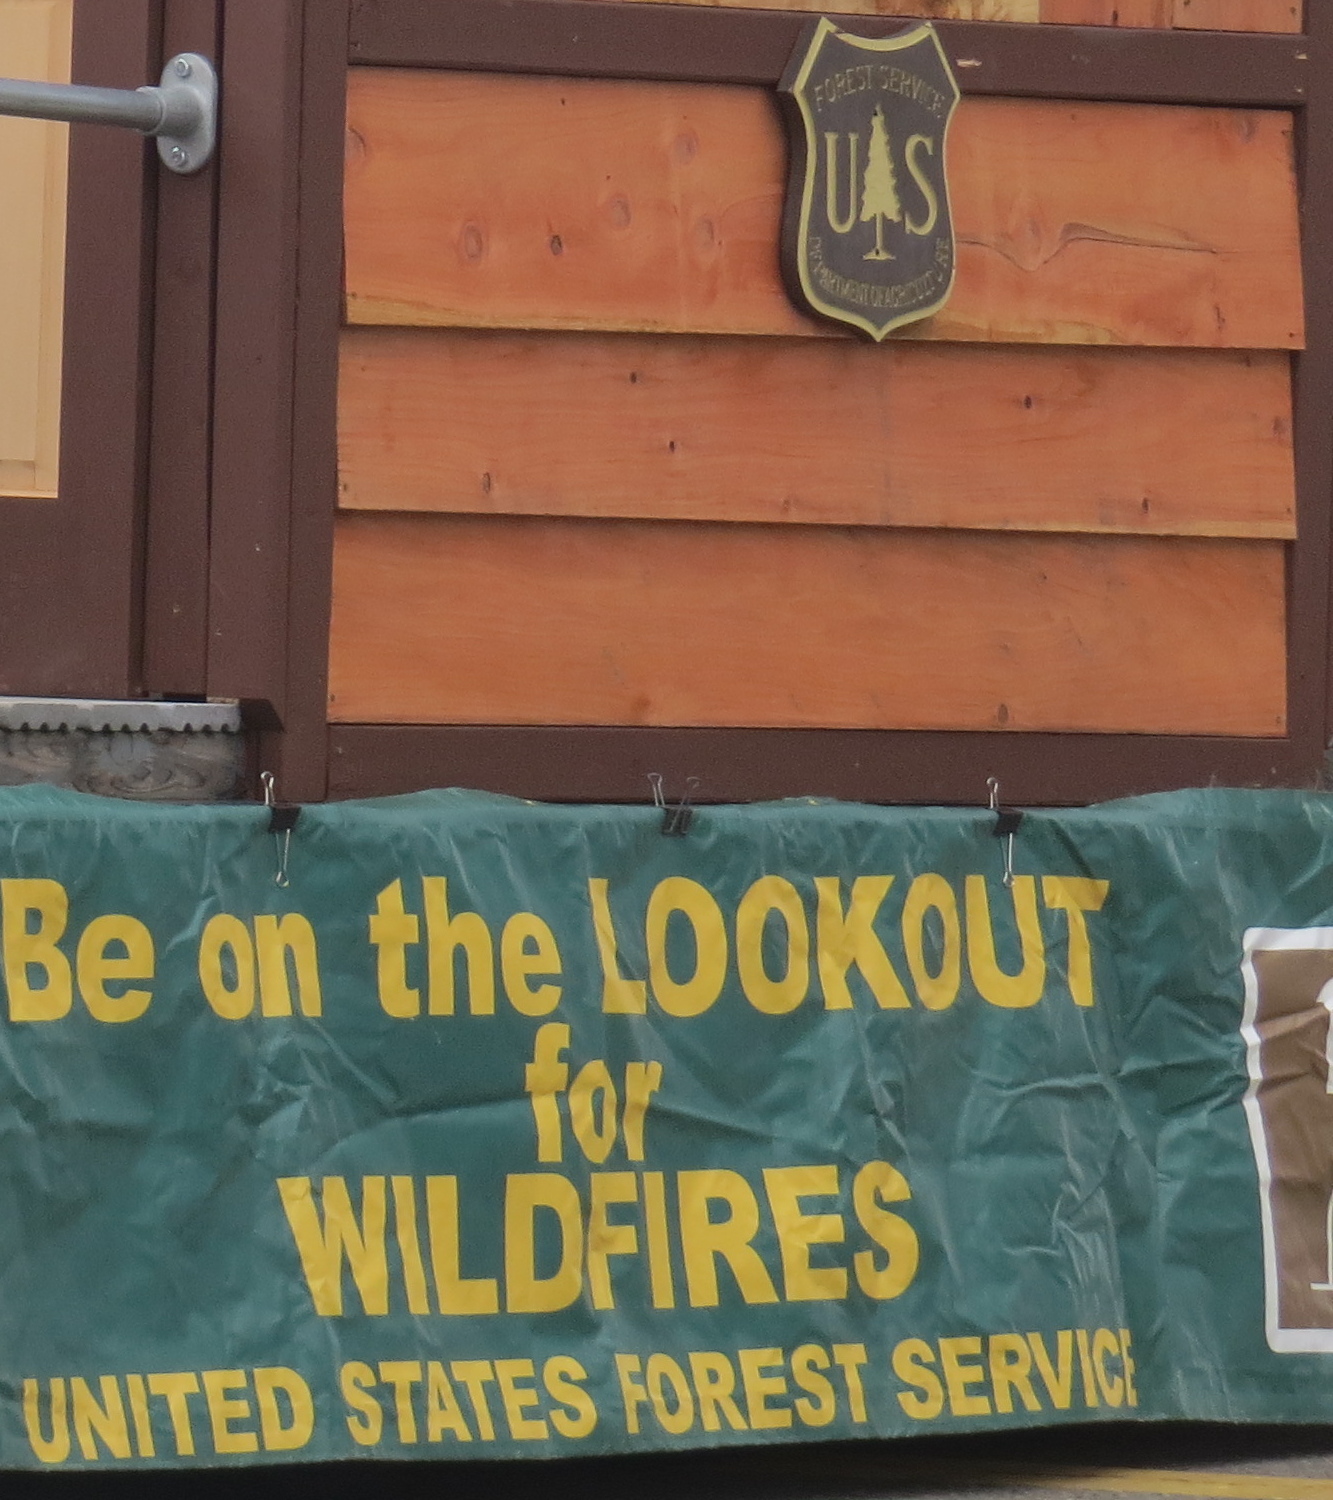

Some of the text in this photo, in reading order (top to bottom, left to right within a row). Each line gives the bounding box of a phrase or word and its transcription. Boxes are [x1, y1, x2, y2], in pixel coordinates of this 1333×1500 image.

[0, 873, 1110, 1022] Be on the LOOKOUT
[524, 1023, 663, 1164] for
[278, 1159, 920, 1317] WILDFIRES
[23, 1327, 1138, 1463] UNITED STATES FOREST SERVICE
